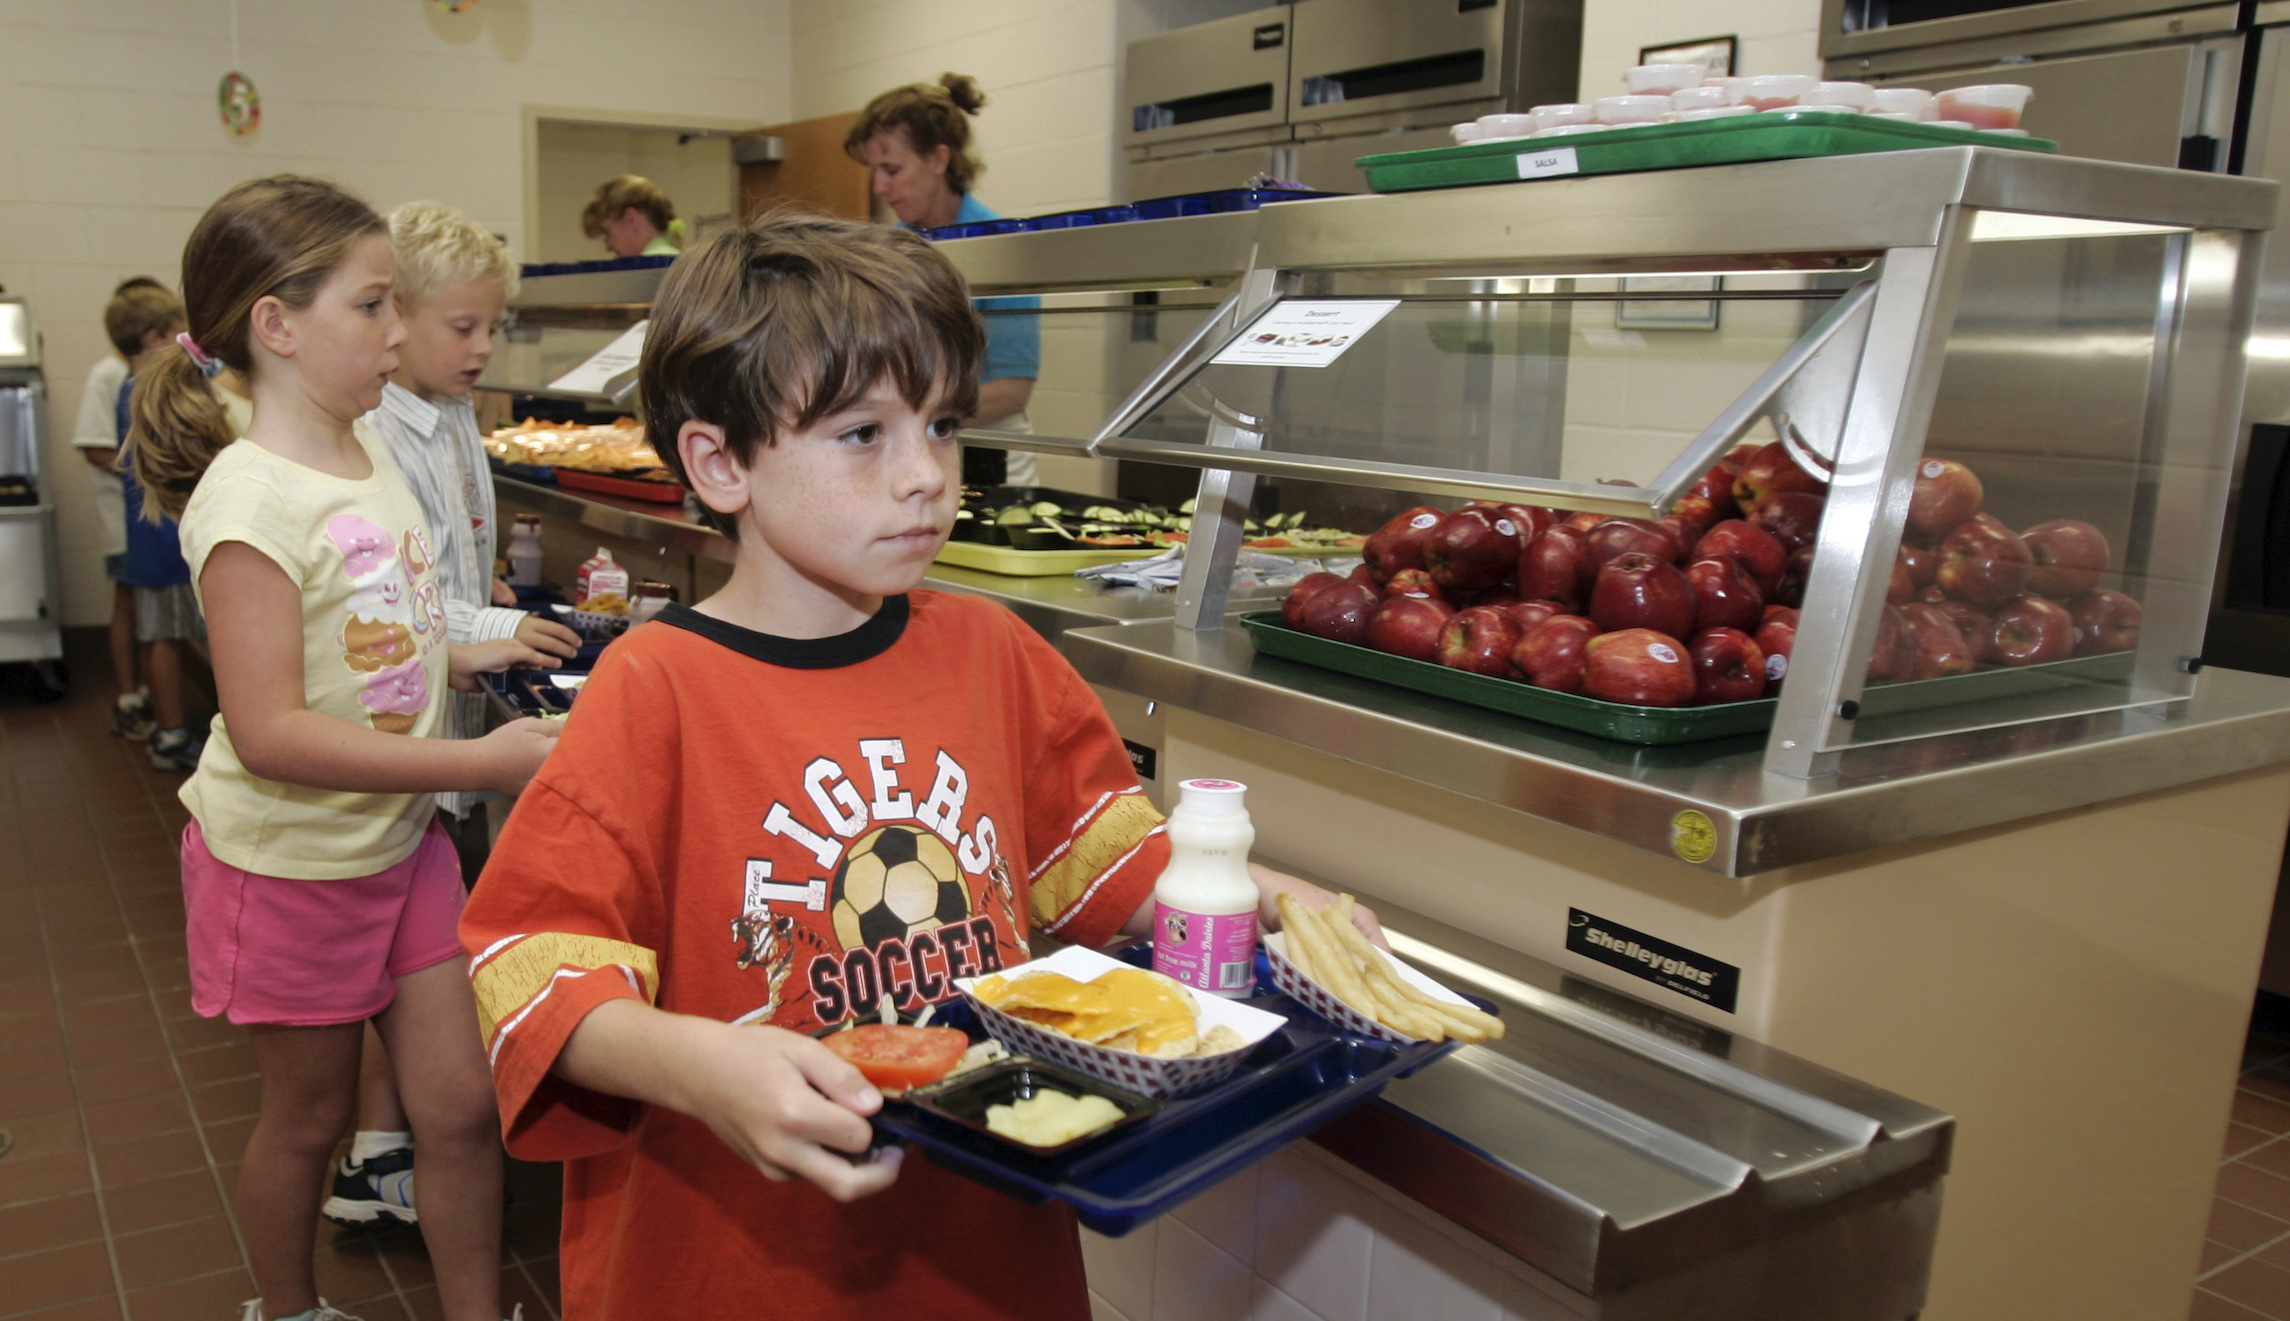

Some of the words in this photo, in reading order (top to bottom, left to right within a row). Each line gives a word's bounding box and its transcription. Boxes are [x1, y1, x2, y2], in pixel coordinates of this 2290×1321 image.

[1535, 158, 1558, 168] SALSA
[399, 525, 435, 586] ICE
[743, 737, 998, 916] TIGERS
[747, 868, 761, 909] Place
[1201, 916, 1214, 951] Dairies
[1585, 927, 1712, 986] Shelleyglas
[808, 914, 1003, 1026] SOCCER
[1180, 959, 1198, 969] milk
